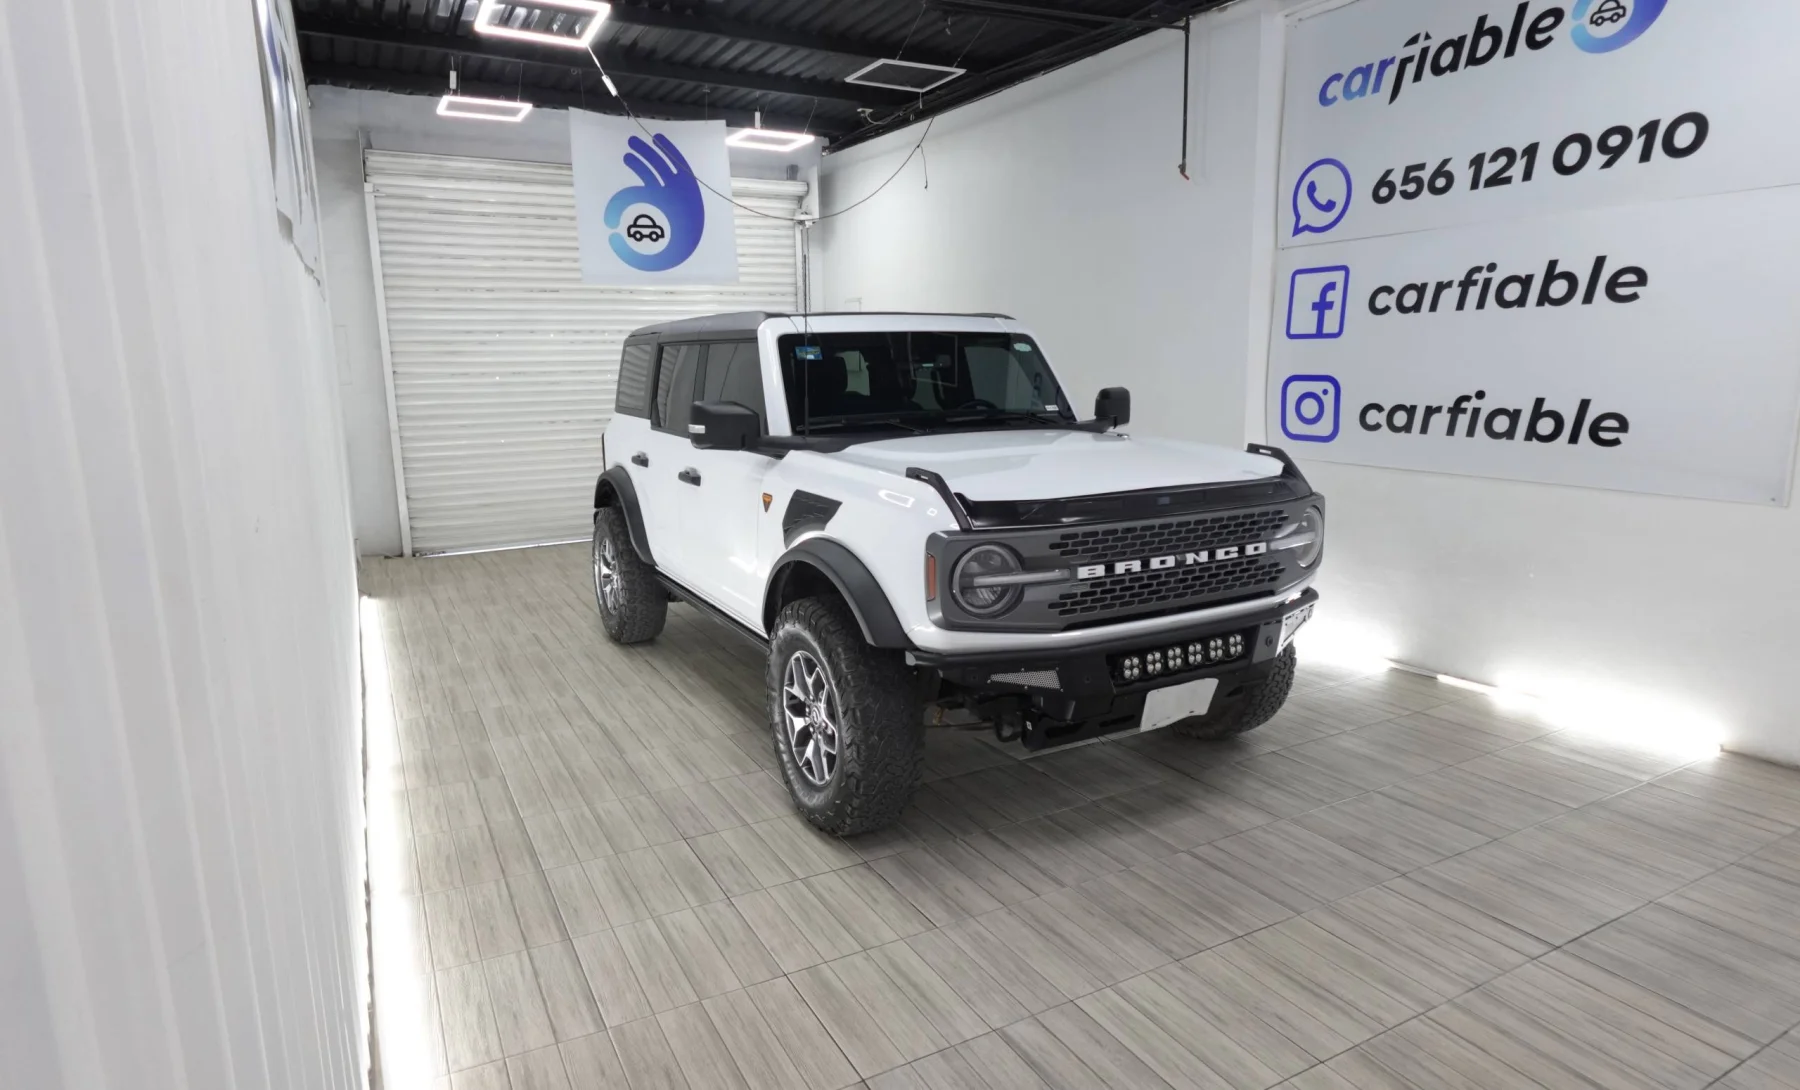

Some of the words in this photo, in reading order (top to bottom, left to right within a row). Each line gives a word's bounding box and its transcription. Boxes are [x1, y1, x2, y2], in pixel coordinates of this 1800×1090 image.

[1318, 1, 1565, 107] carfiable
[1371, 157, 1455, 205] 656
[1468, 141, 1541, 191] 121
[1552, 111, 1709, 176] 0910
[1367, 255, 1648, 316] carfiable
[1358, 389, 1630, 448] carfiable
[1077, 541, 1268, 580] BRONCO
